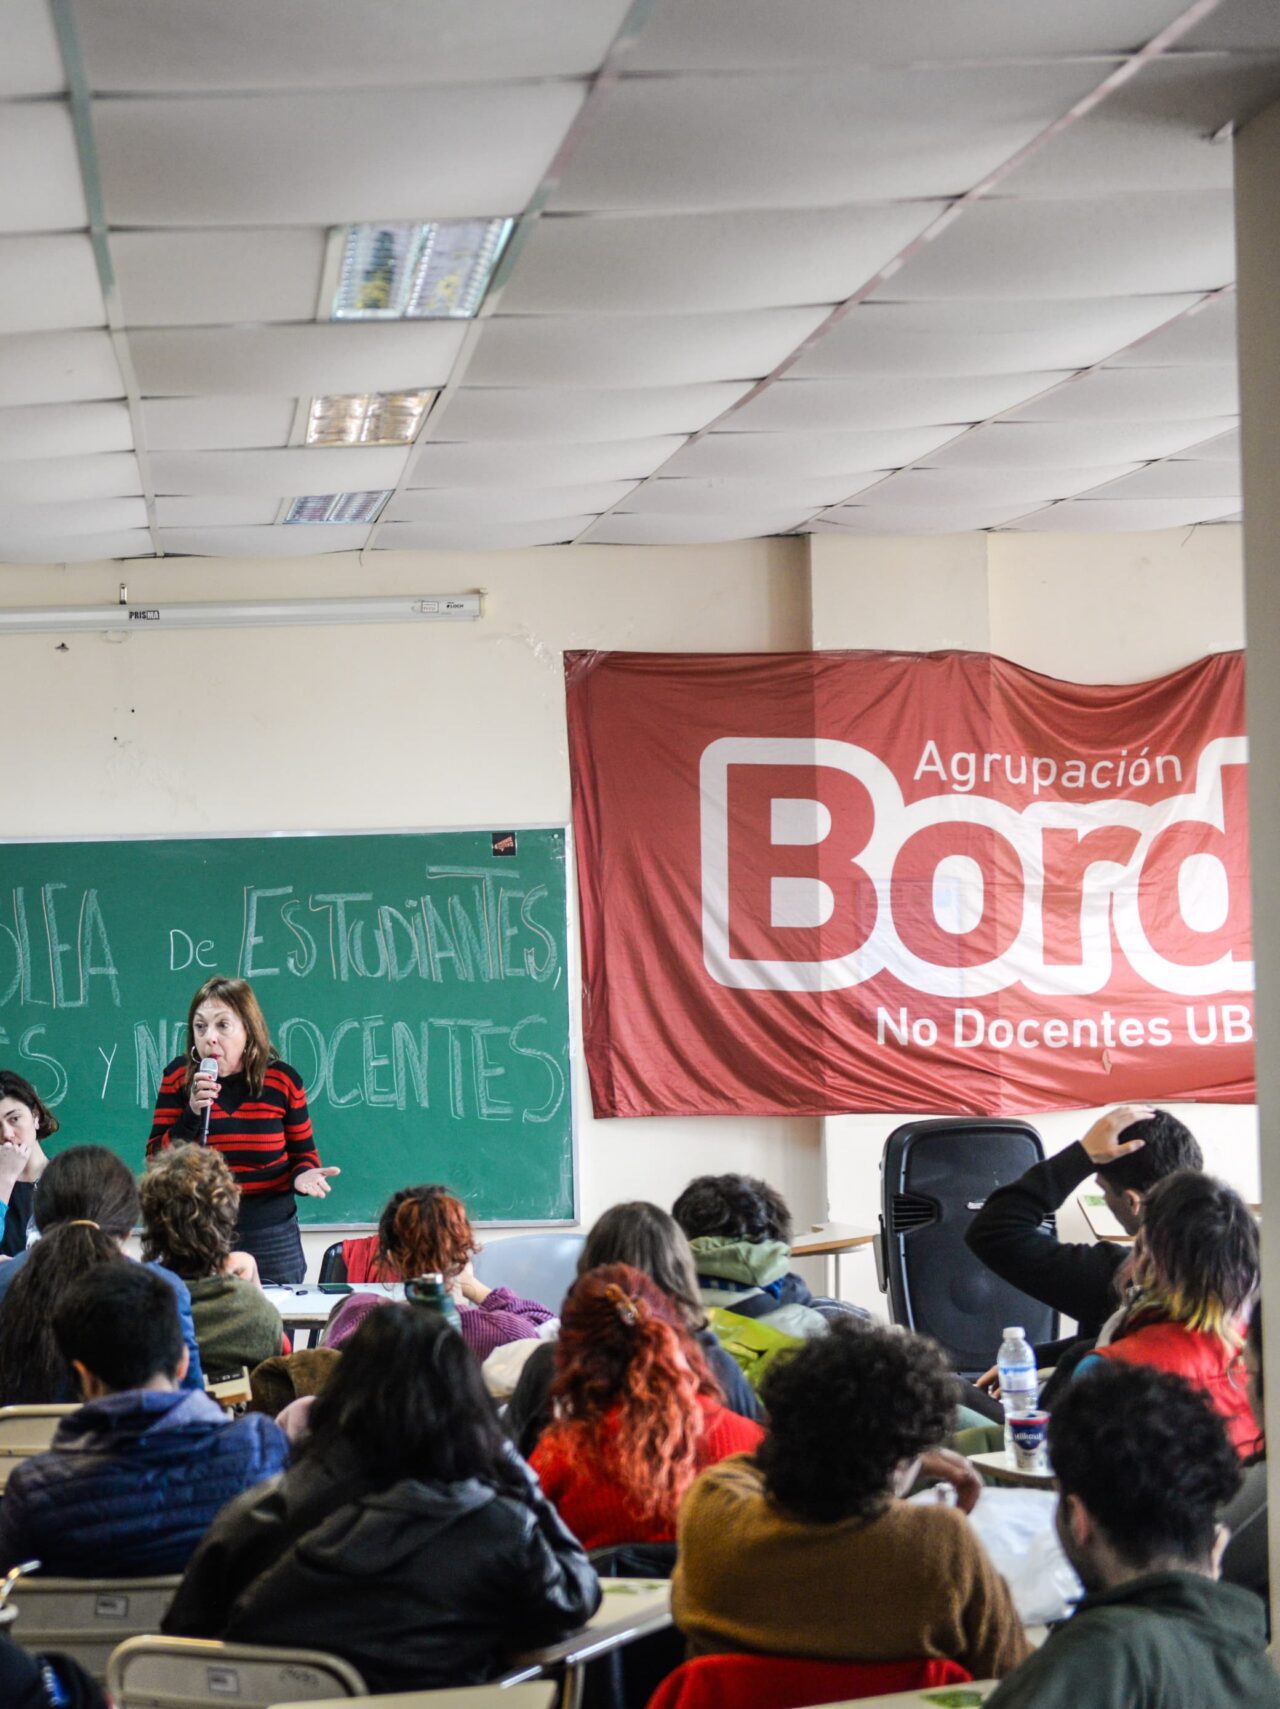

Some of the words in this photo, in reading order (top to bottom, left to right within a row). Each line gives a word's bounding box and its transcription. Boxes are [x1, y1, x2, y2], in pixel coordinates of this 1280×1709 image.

[913, 740, 1183, 794] Agrupación
[169, 929, 218, 971] De
[877, 1007, 938, 1047] No
[954, 1008, 1173, 1048] Docentes
[1185, 1004, 1254, 1046] UB
[278, 1015, 565, 1123] OCENTES
